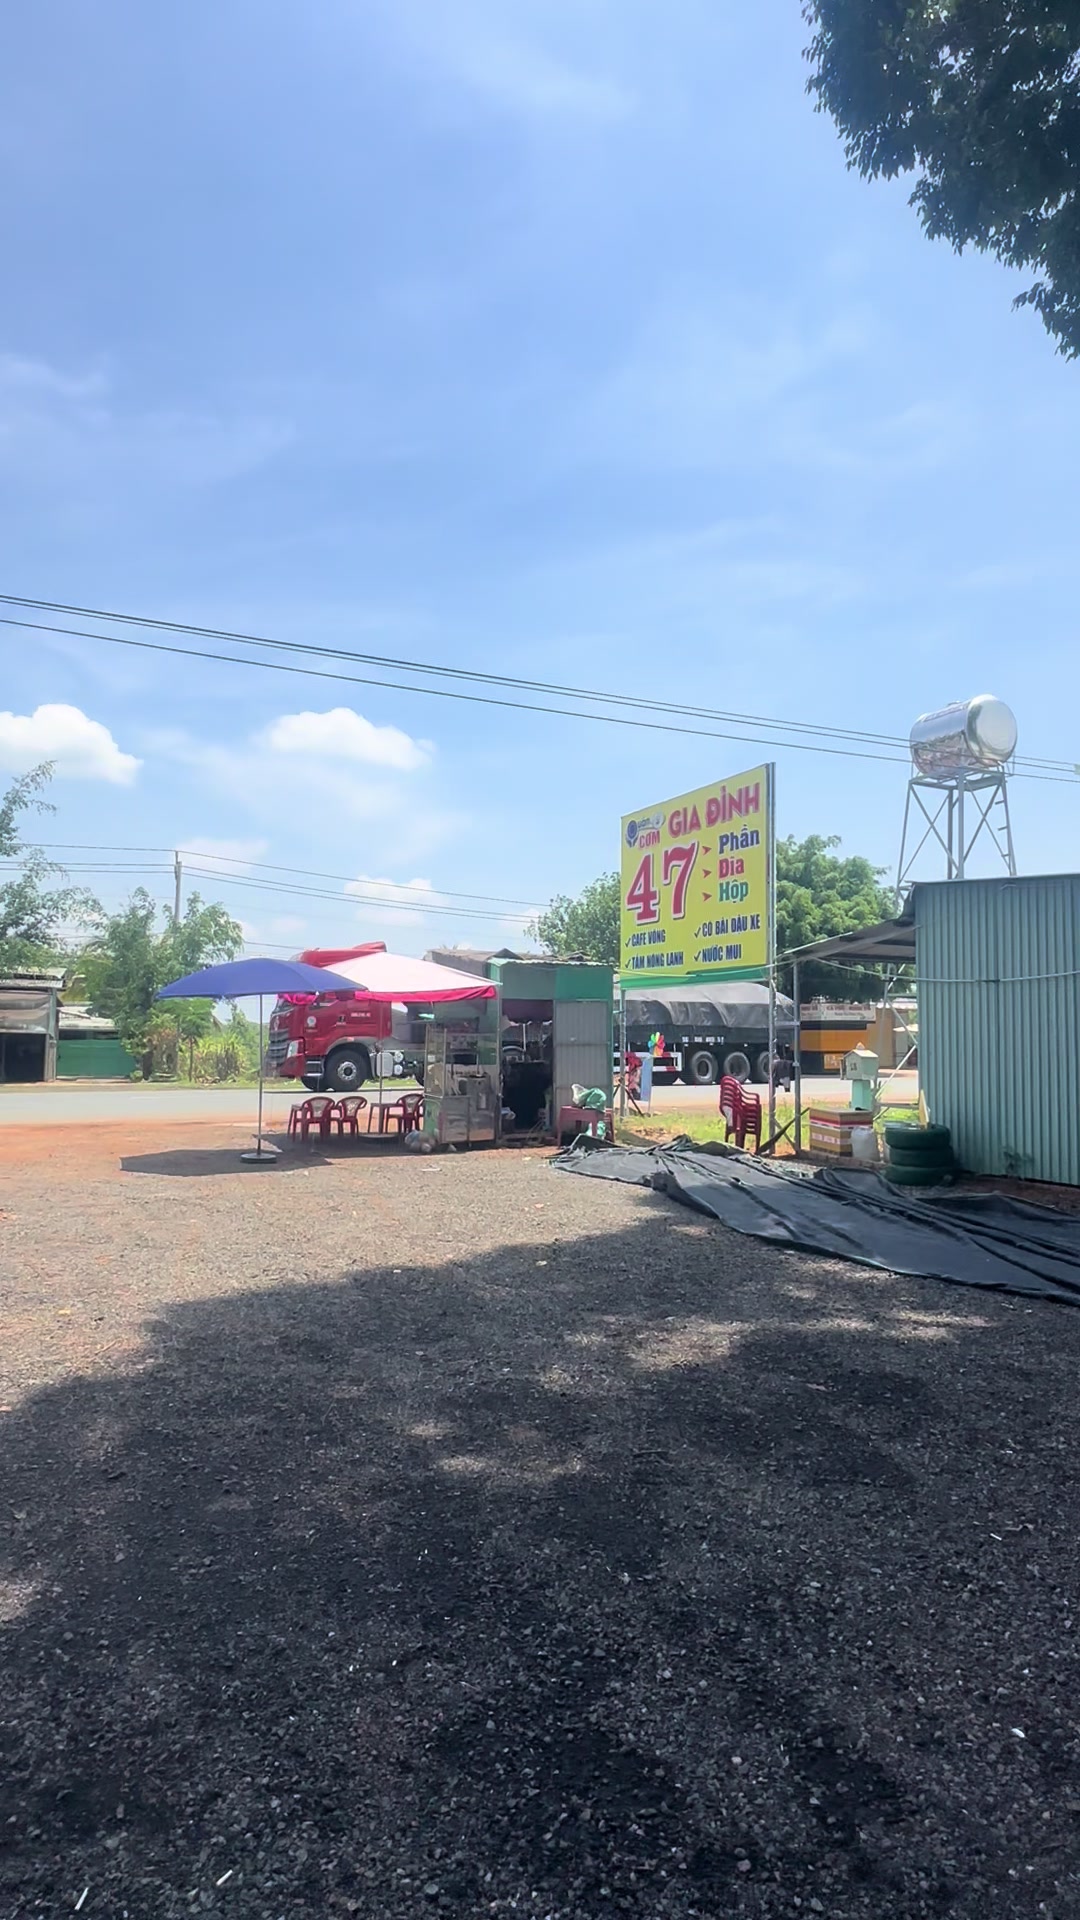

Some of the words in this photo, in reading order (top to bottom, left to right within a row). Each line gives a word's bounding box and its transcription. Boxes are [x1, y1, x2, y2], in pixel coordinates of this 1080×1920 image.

[668, 803, 700, 838] GIA
[706, 783, 759, 827] ĐÌNH
[638, 829, 660, 848] CƠM
[718, 823, 759, 854] Phần
[626, 841, 698, 925] 47
[718, 879, 748, 902] Hộp
[750, 914, 760, 929] XE
